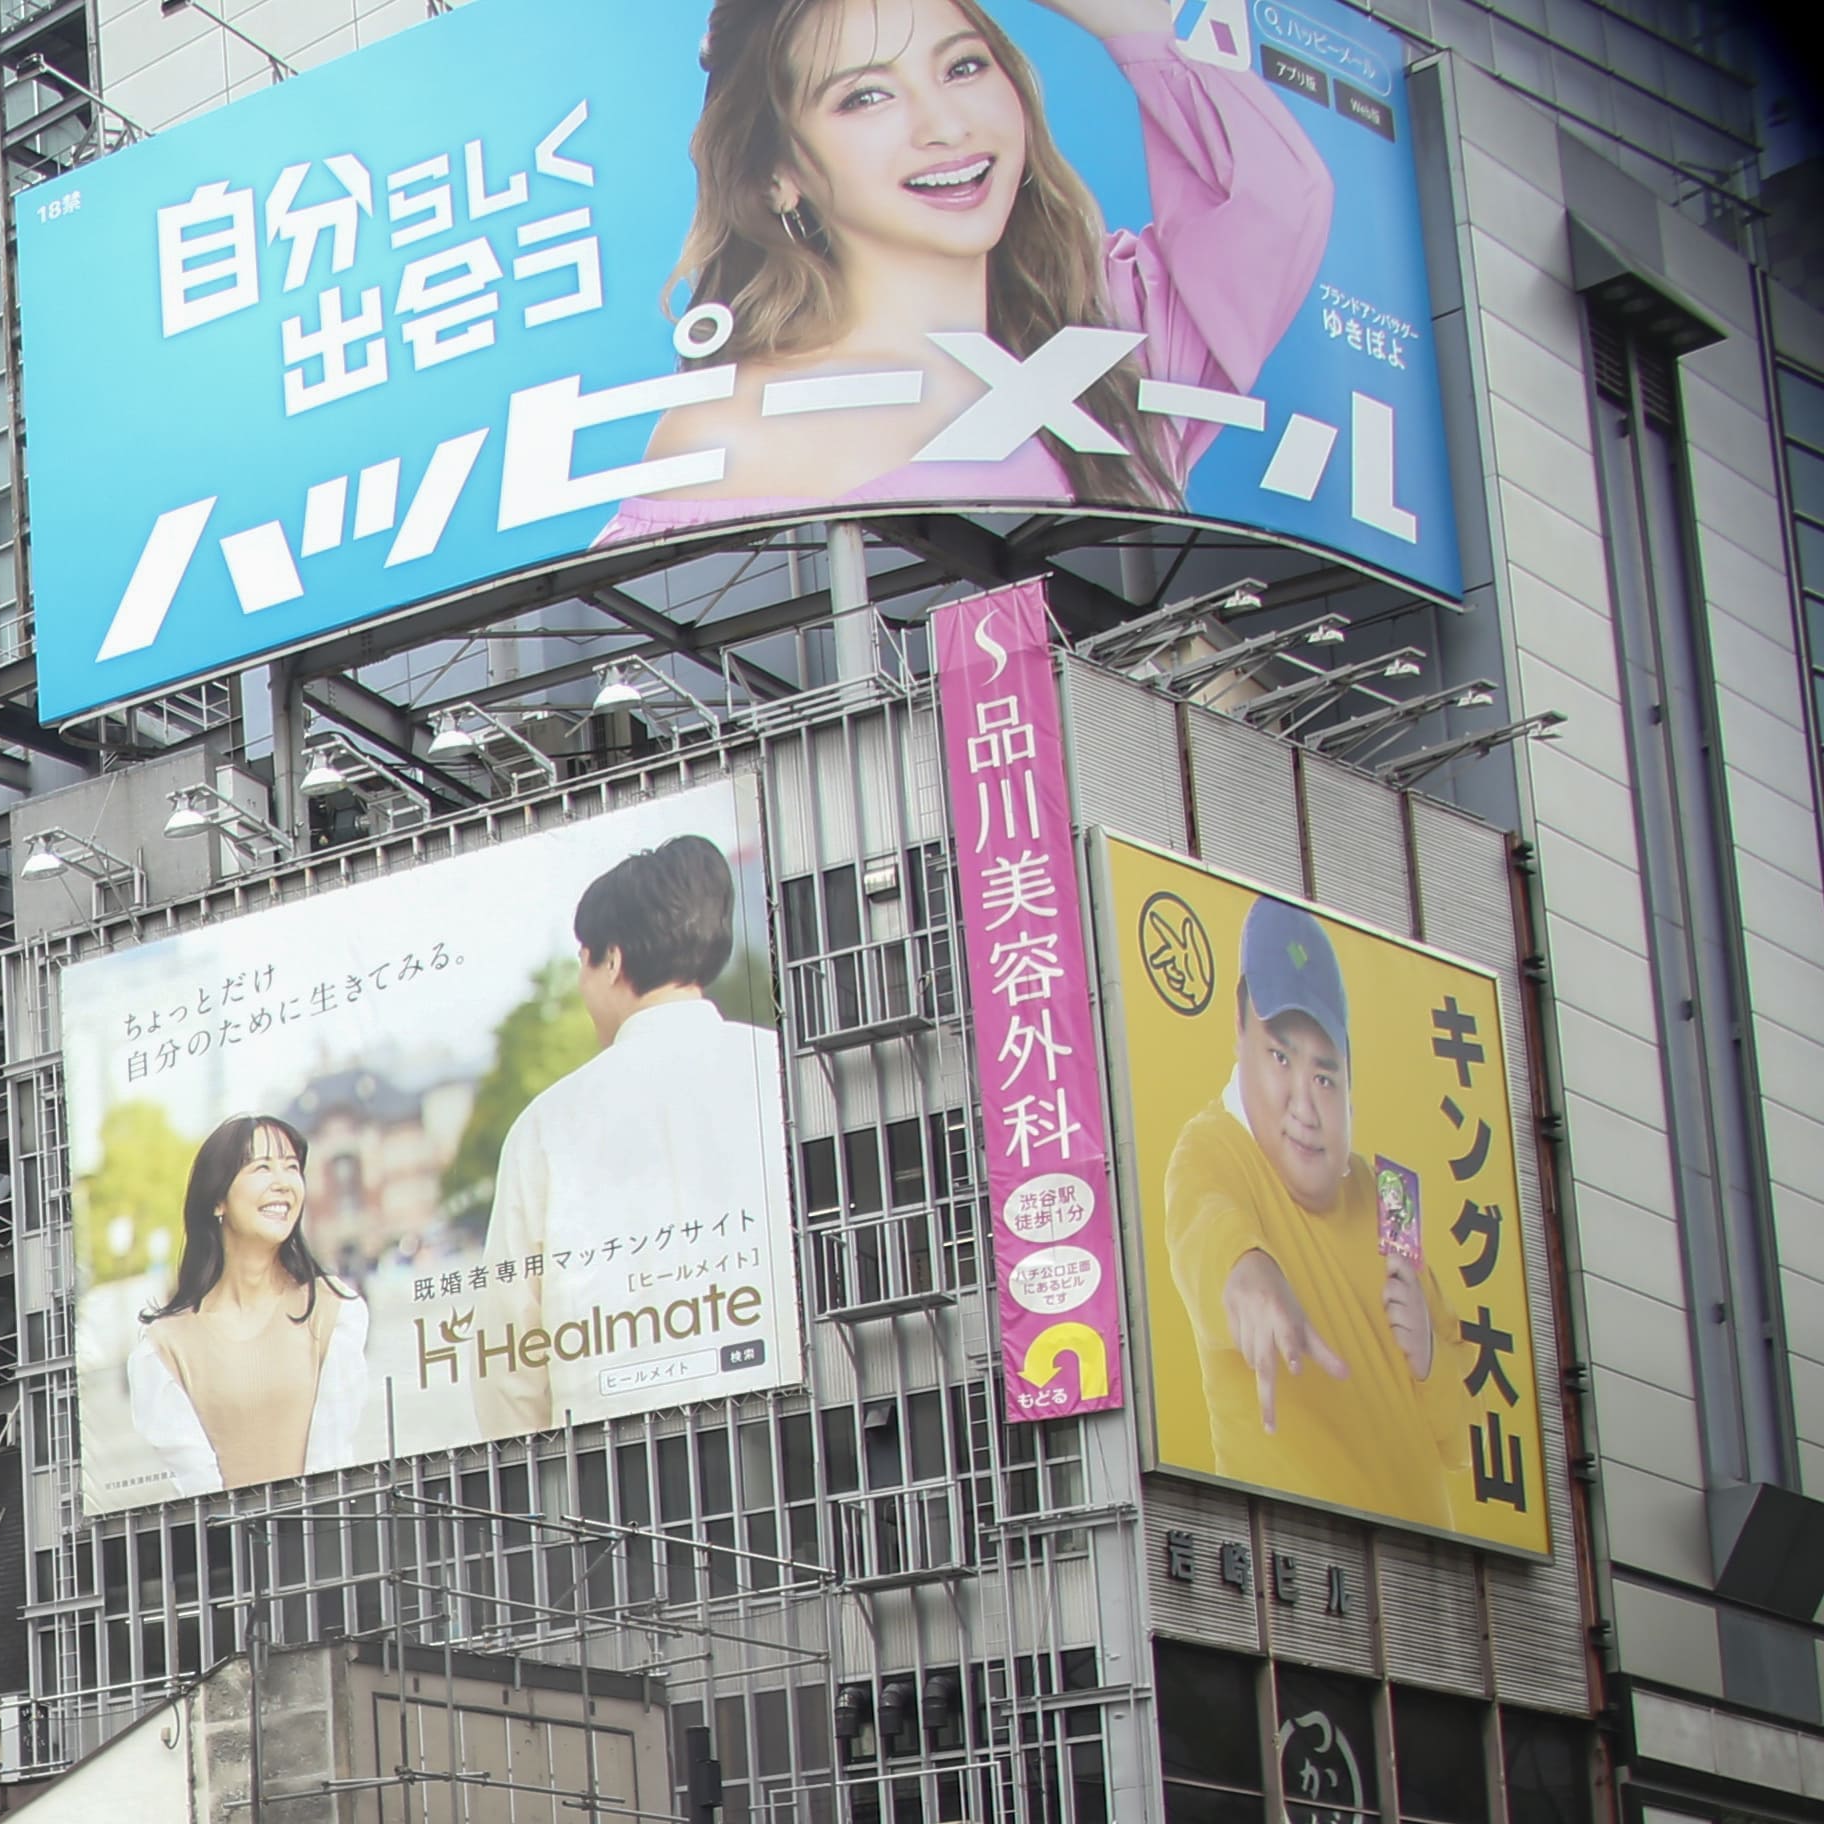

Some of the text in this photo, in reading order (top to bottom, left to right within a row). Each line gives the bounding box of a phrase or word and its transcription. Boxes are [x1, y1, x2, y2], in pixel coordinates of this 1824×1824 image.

[36, 190, 83, 225] 18禁
[157, 98, 595, 339] 自分らしく
[283, 206, 604, 418] 出会う
[1322, 307, 1406, 371] ゆきぽよ
[95, 302, 1418, 663] ハッピーメール
[967, 695, 1082, 1170] 品川美容外科
[124, 963, 275, 1042] ちょっとだけ
[126, 942, 465, 1083] 自分のために生きてみる。
[1014, 1204, 1085, 1232] 徒歩1分
[1019, 1185, 1076, 1212] 渋谷駅
[412, 1208, 756, 1302] 既婚者専用マッチングサイト
[1016, 1259, 1091, 1282] ハチ公口正面
[1023, 1277, 1086, 1296] にあるビル
[1429, 994, 1529, 1515] キング大山
[476, 1283, 763, 1379] Healmate
[1044, 1291, 1068, 1306] です
[605, 1360, 689, 1390] ヒールメイト
[729, 1348, 756, 1365] 検索
[1017, 1387, 1069, 1409] もどる
[1168, 1529, 1351, 1618] 岩崎ビル
